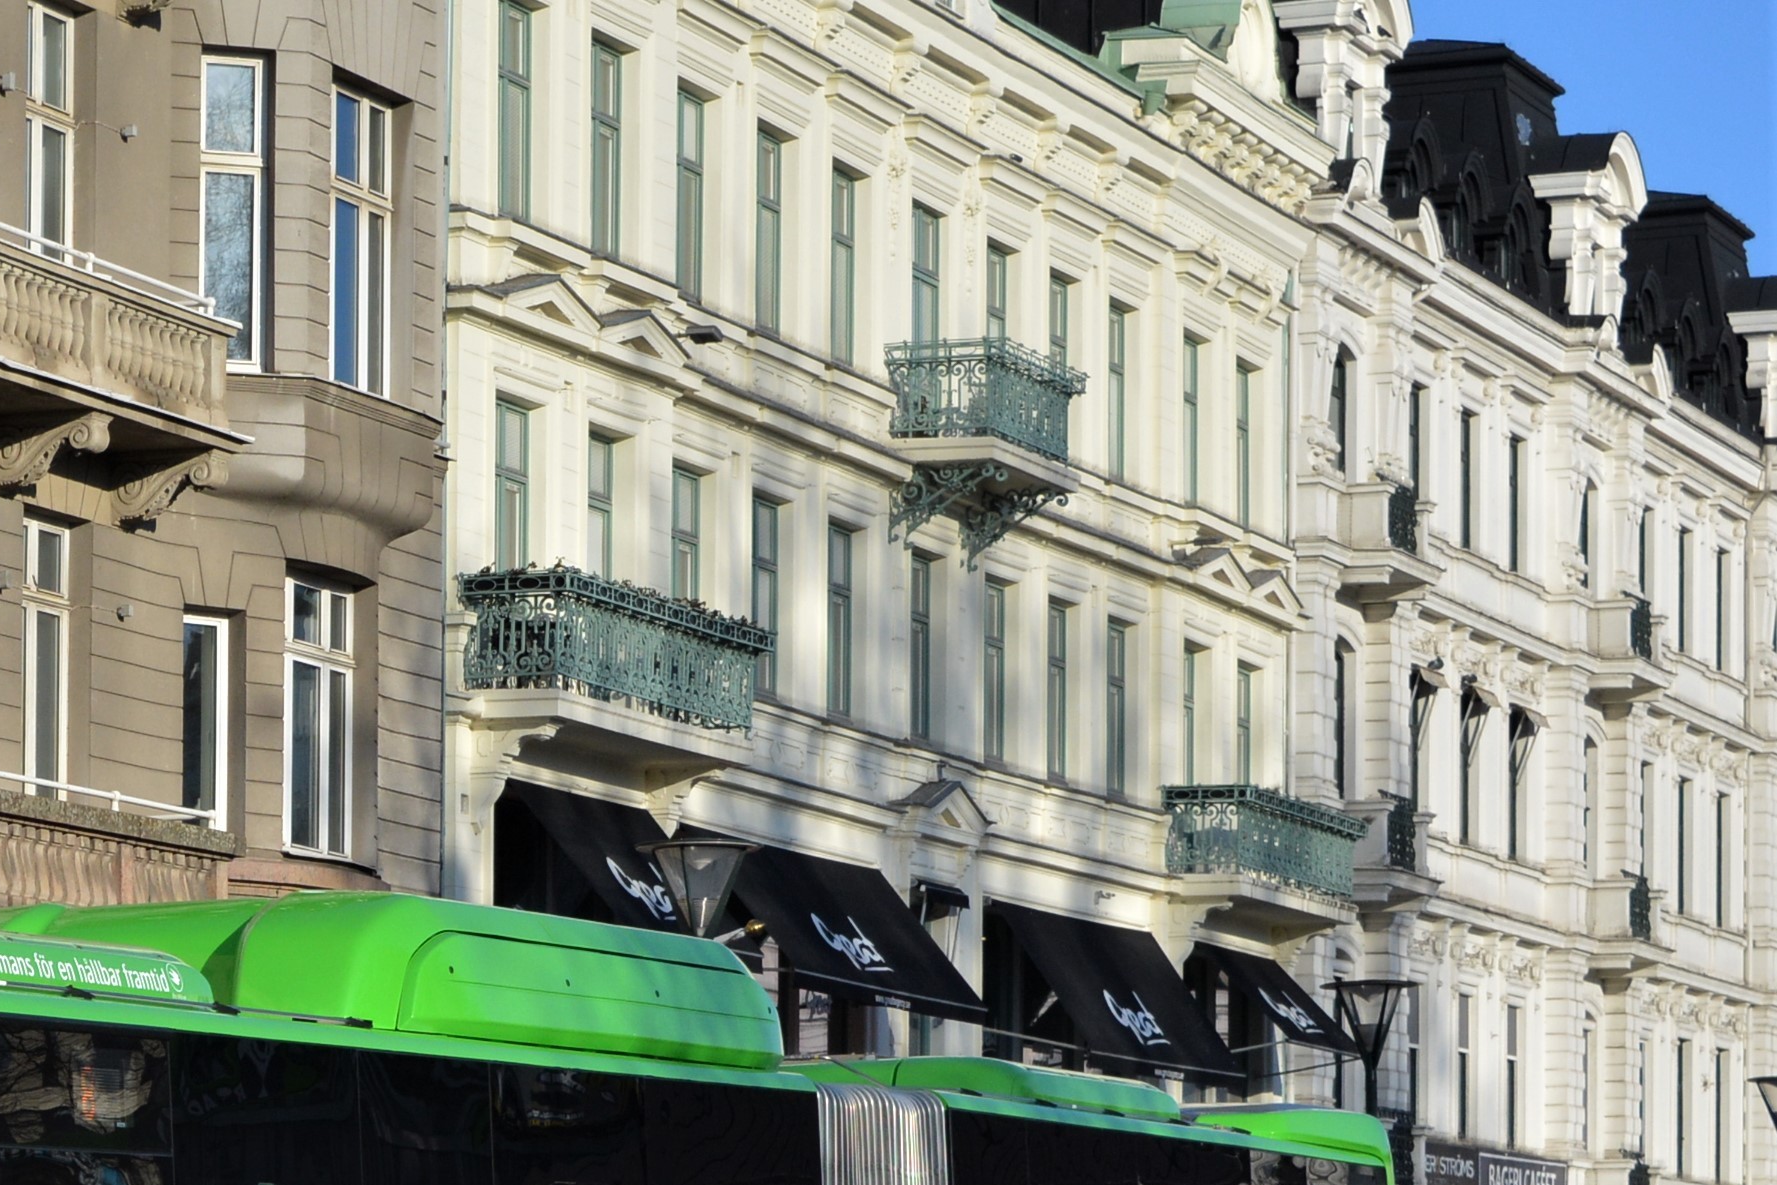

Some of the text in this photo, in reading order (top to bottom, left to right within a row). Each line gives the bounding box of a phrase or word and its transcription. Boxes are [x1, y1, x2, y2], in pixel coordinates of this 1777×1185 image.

[34, 951, 56, 980] för
[59, 963, 75, 982] en
[74, 956, 122, 988] hållbar
[122, 964, 170, 993] framtid
